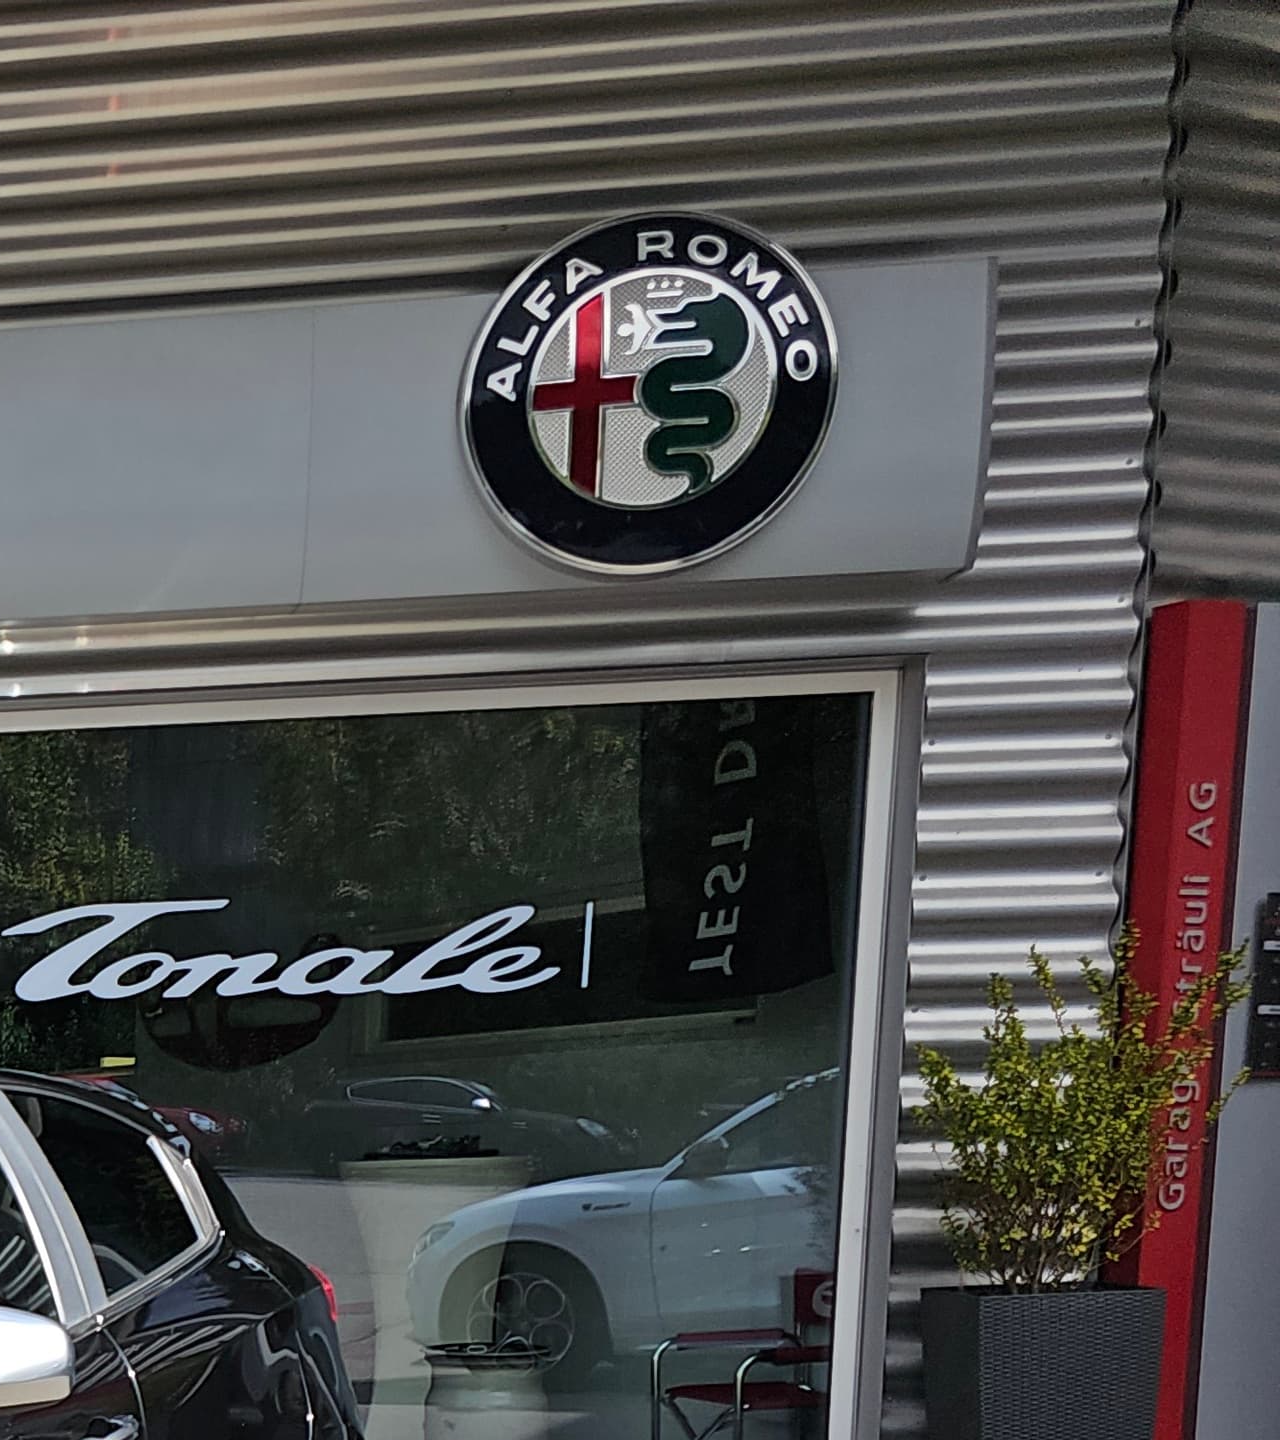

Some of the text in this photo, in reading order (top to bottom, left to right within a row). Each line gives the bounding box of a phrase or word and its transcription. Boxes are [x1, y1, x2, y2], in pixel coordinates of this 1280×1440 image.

[487, 230, 818, 401] ALFA ROMEO
[1188, 781, 1218, 847] AG
[0, 898, 561, 1002] Tonale
